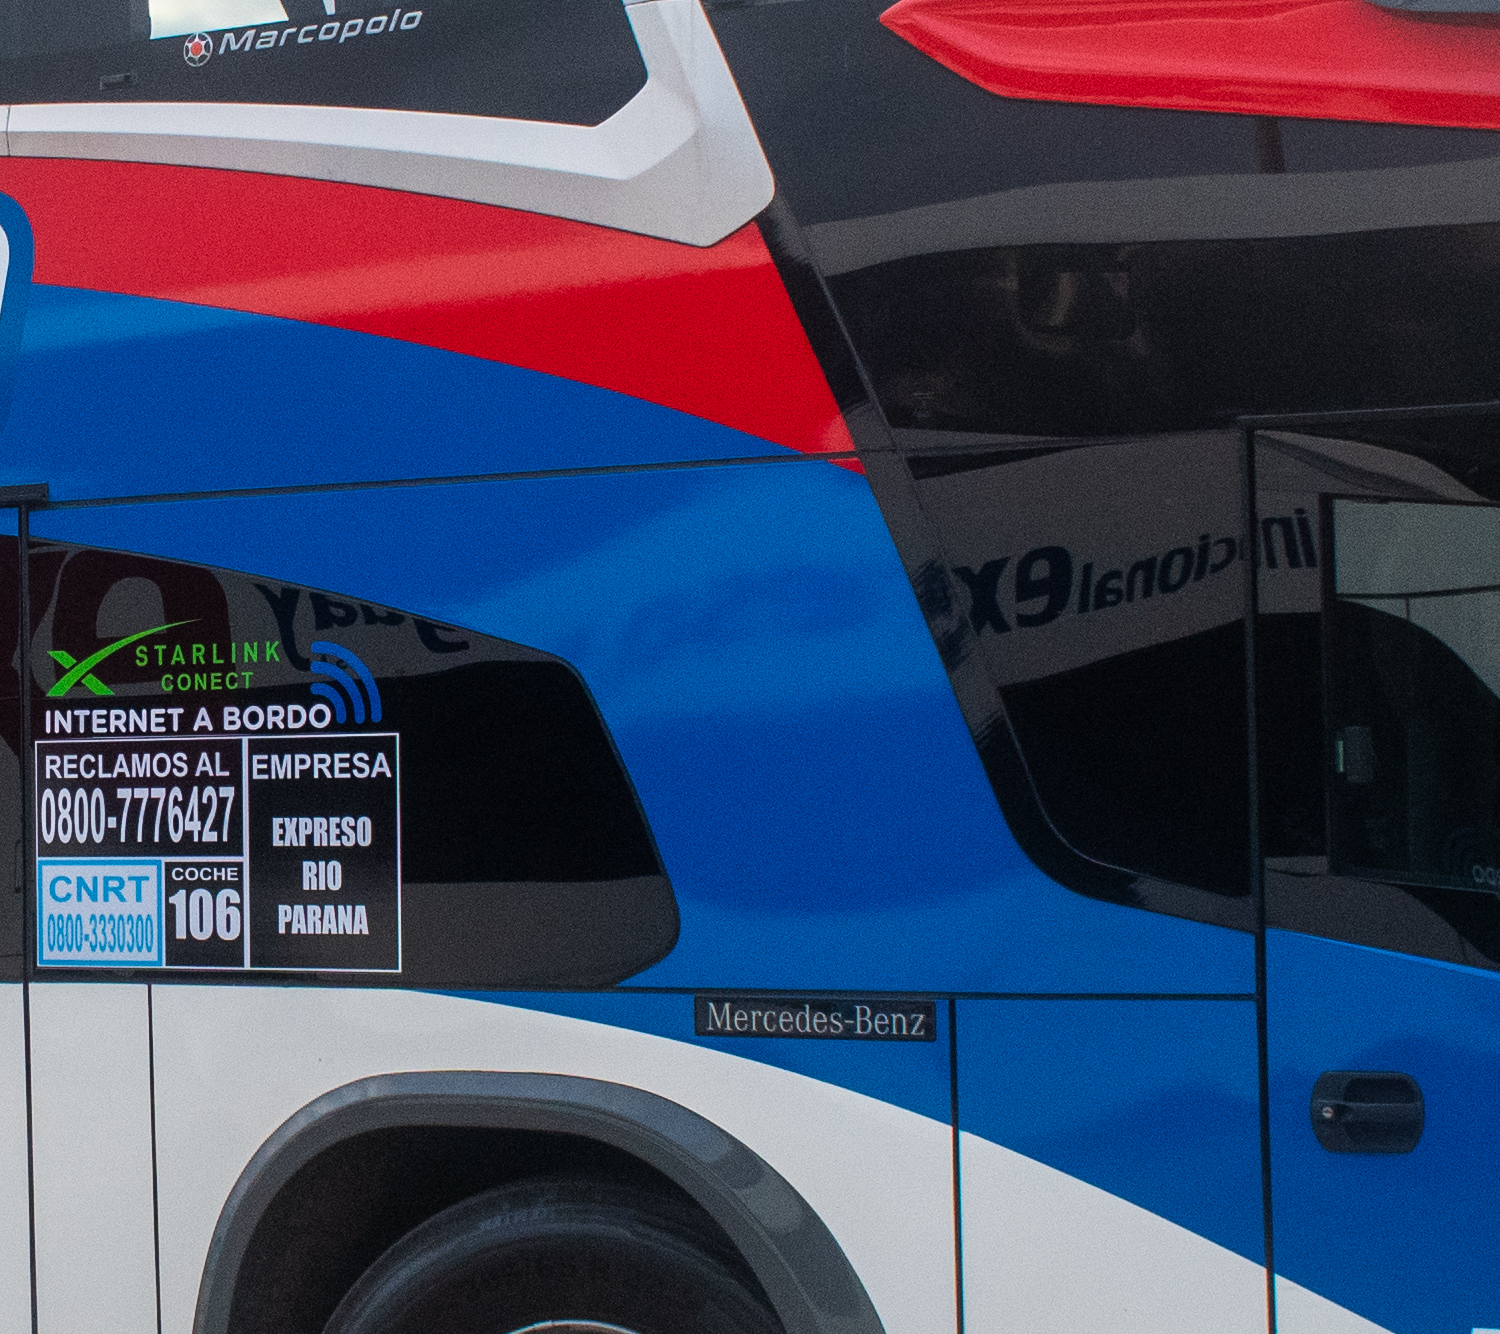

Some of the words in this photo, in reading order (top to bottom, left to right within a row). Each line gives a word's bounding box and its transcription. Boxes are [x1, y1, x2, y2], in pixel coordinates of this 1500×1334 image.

[218, 8, 424, 55] Marcopolo
[135, 640, 280, 666] STARLINK
[161, 671, 254, 692] CONECT
[45, 707, 184, 734] INTERNET
[193, 708, 213, 731] A
[223, 703, 332, 730] BORDO
[45, 753, 188, 778] RECLAMOS
[195, 752, 230, 776] AL
[252, 753, 392, 779] EMPRESA
[41, 786, 235, 844] 0800-7776427
[272, 816, 372, 847] EXPRESO
[49, 875, 150, 903] CNRT
[171, 867, 239, 882] COCHE
[302, 861, 342, 891] RIO
[168, 889, 241, 940] 106
[278, 904, 369, 935] PARANA
[47, 914, 153, 952] 0800-3330300
[706, 1002, 926, 1036] Mercedes-Benz
